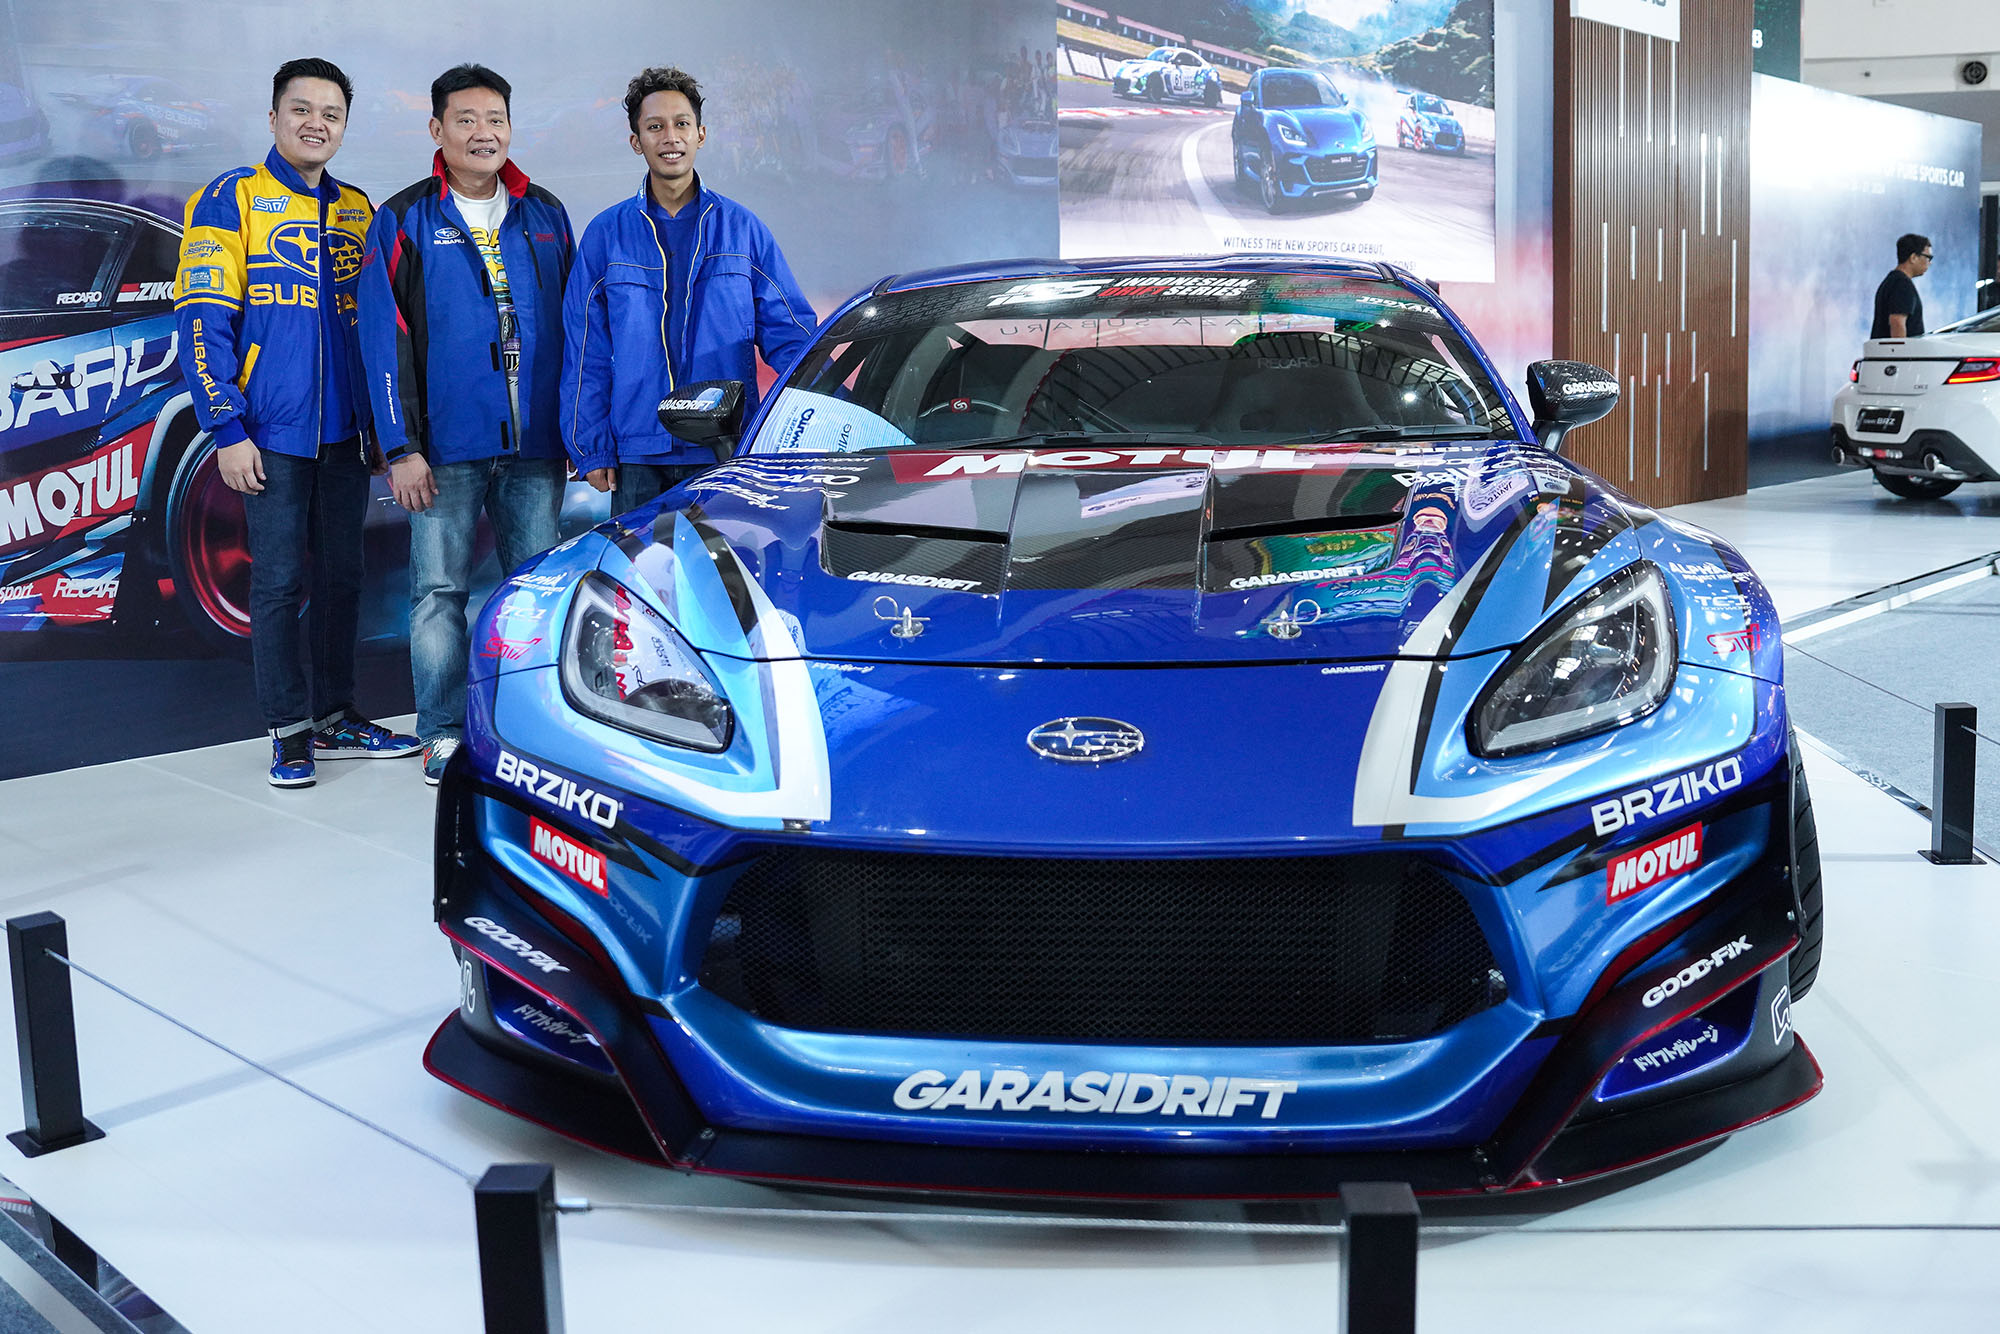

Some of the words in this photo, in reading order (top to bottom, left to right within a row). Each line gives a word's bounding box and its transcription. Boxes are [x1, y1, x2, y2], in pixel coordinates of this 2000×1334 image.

[1919, 165, 1948, 186] SPORTS
[1949, 169, 1965, 188] CAR
[1223, 236, 1263, 249] WITNESS
[1266, 239, 1282, 250] THE
[1285, 240, 1305, 251] NEW
[1307, 241, 1338, 252] SPORTS
[1341, 242, 1357, 253] CAR
[1098, 286, 1171, 297] DRIFT
[1161, 287, 1248, 297] SERIES
[1113, 276, 1257, 288] INDONESIAN
[56, 291, 103, 305] RECARO
[1876, 416, 1896, 426] BRZ
[925, 448, 1317, 479] MOTUL
[0, 442, 139, 547] MOTUL
[1229, 564, 1367, 589] GARASIDRIFT
[1668, 561, 1727, 575] ALPHA
[53, 578, 120, 599] RECAR
[847, 570, 982, 592] GARASIDRIFT
[1321, 664, 1386, 675] GARASIDRIFT
[495, 750, 620, 829] BRZIKO
[1591, 756, 1743, 837] BRZIKO
[534, 825, 605, 889] MOTUL
[1610, 831, 1699, 897] MOTUL
[464, 916, 571, 973] GOOD-FIX
[1642, 935, 1754, 1009] GOOD-FIX
[1632, 1024, 1720, 1073] ドリフトガレージ
[892, 1069, 1298, 1120] GARASIDRIFT
